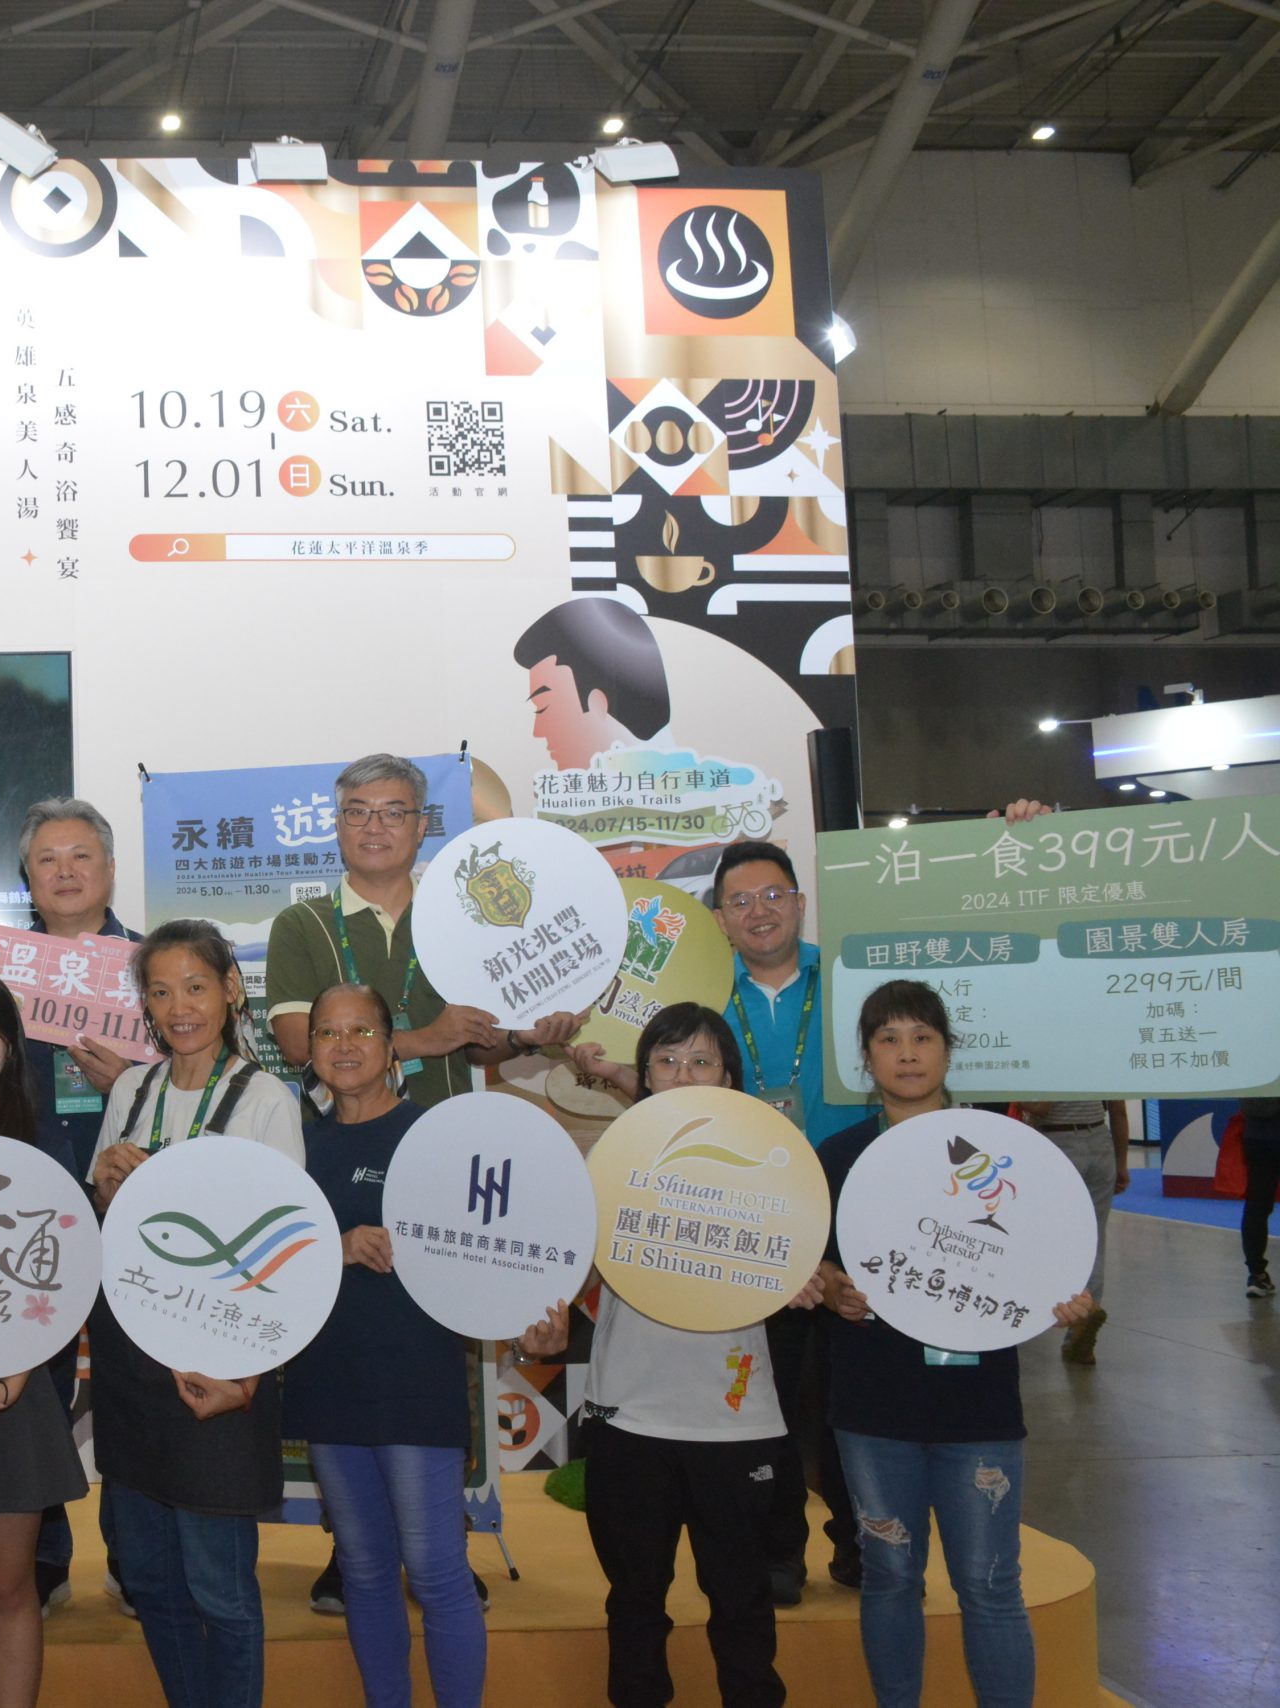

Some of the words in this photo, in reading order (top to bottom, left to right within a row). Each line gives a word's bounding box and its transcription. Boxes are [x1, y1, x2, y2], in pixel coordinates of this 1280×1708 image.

[14, 307, 40, 521] 英雄泉美人湯
[130, 389, 267, 429] 10.19
[284, 398, 312, 424] 六
[329, 409, 393, 434] Sat.
[53, 366, 80, 581] 五感奇浴饗宴
[134, 458, 264, 498] 12.01
[289, 464, 311, 489] 日
[329, 473, 396, 498] Sun.
[291, 539, 430, 557] 花蓮太平洋溫泉季
[538, 768, 732, 796] 花蓮魅力自行車道
[541, 798, 596, 809] Hualien
[601, 796, 634, 807] Bike
[640, 794, 682, 806] Trails
[172, 816, 255, 852] 永續
[823, 811, 1280, 887] 一泊一食399元/人
[175, 851, 347, 872] 四大旅遊市場獎勵方
[176, 887, 197, 895] 2024
[200, 886, 223, 897] 5.10
[244, 884, 270, 896] 11.30
[961, 891, 1010, 912] 2024
[1018, 888, 1050, 908] ITF
[1058, 880, 1147, 905] 限定優惠
[482, 905, 587, 983] 新光兆豐
[865, 933, 1015, 968] 田野雙人房
[1085, 917, 1251, 956] 園景雙人房
[500, 932, 604, 1011] 休閒農場
[1105, 965, 1244, 995] 2299元/間
[1138, 1025, 1217, 1044] 買五送一
[1129, 1050, 1231, 1070] 假日不加價
[627, 1169, 651, 1188] Li
[653, 1174, 724, 1201] Shiuan
[729, 1190, 791, 1215] HOTEL
[659, 1196, 764, 1224] INTERNATIONAL
[395, 1220, 577, 1266] 花蓮縣旅館商業同業公會
[616, 1207, 791, 1262] 麗軒國際飯店
[917, 1216, 977, 1249] Chihsing
[978, 1239, 1005, 1257] Tan
[931, 1231, 981, 1262] Katsuo
[423, 1244, 458, 1259] Hualien
[462, 1252, 487, 1265] Hotel
[491, 1256, 545, 1275] Association
[609, 1241, 634, 1263] Li
[640, 1246, 722, 1280] Shiuan
[730, 1270, 784, 1292] HOTEL
